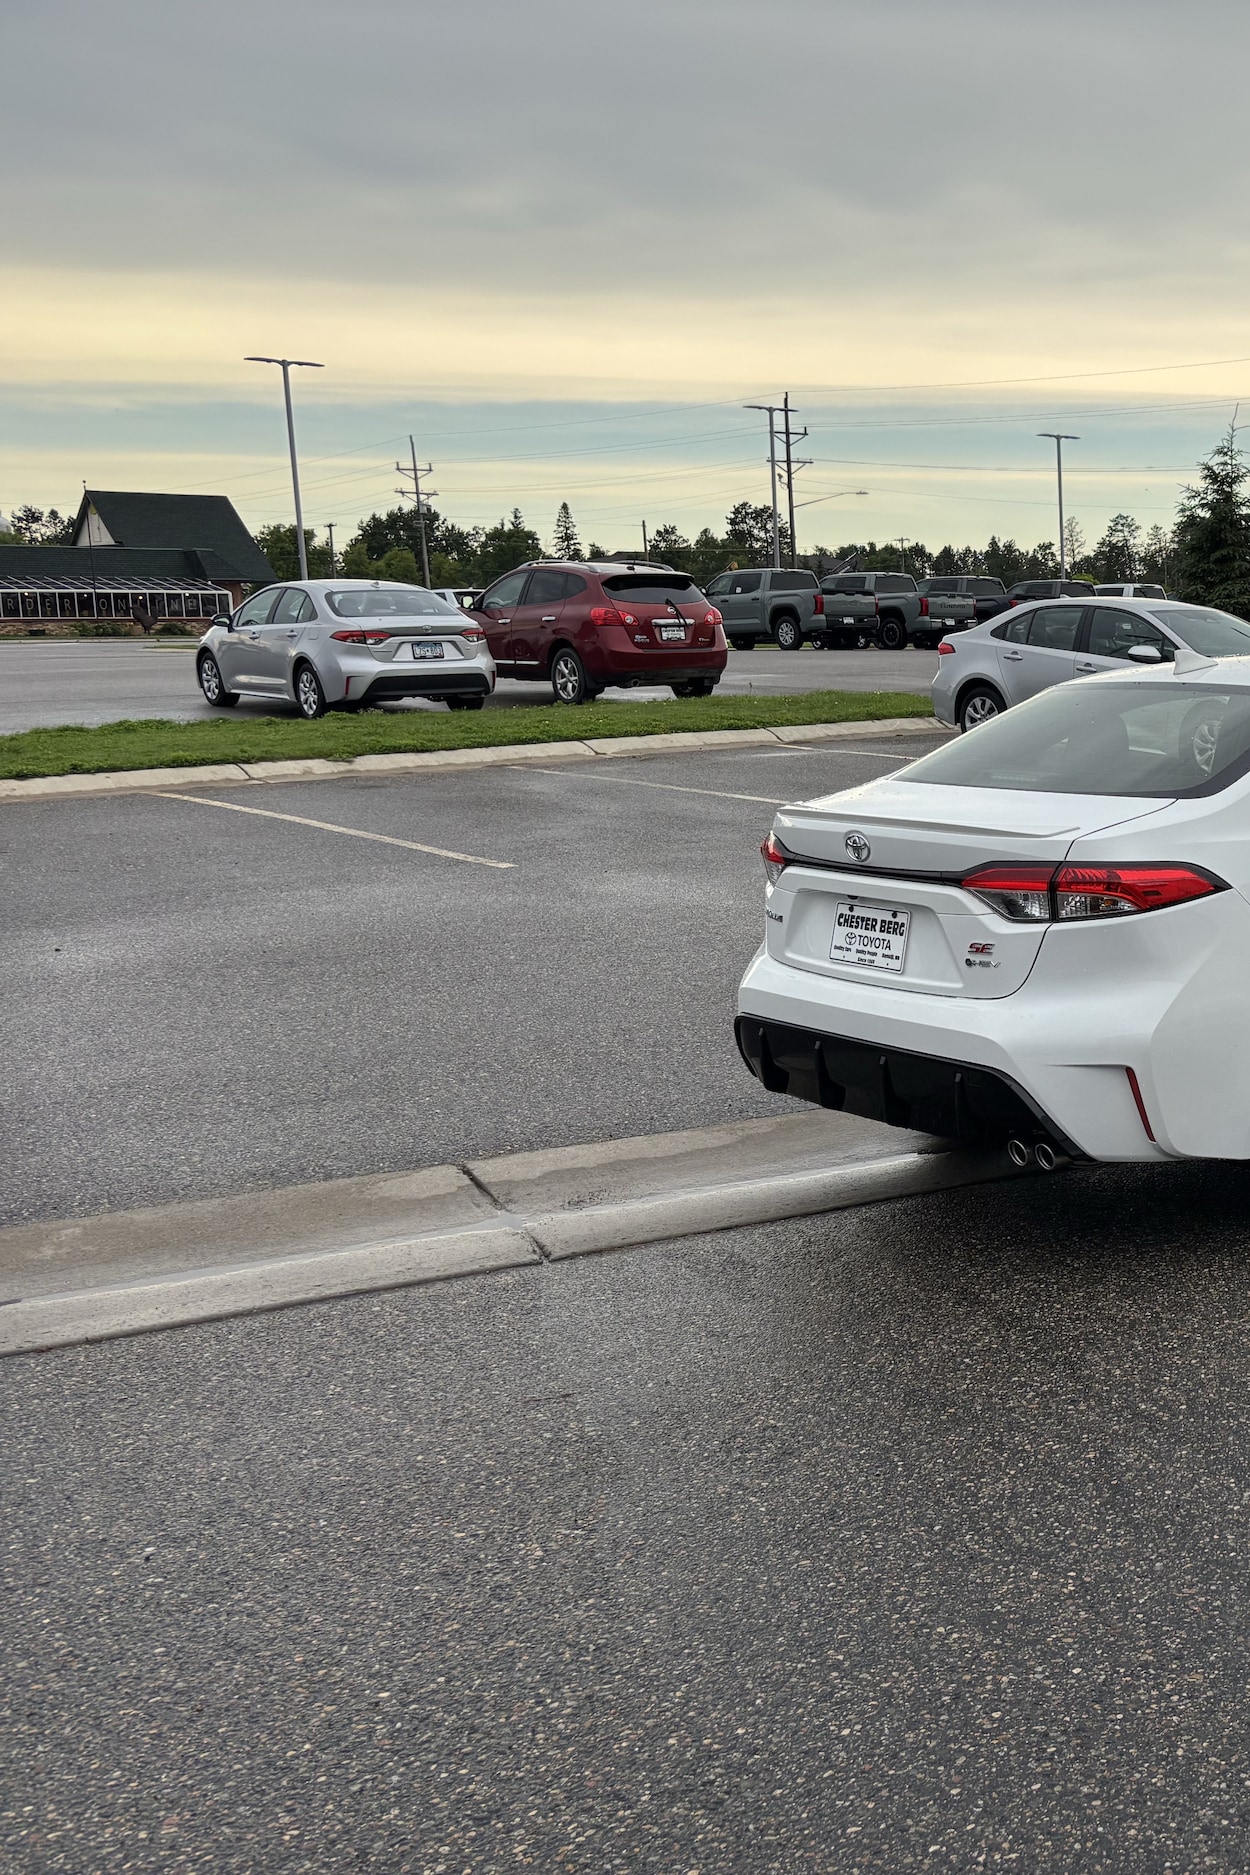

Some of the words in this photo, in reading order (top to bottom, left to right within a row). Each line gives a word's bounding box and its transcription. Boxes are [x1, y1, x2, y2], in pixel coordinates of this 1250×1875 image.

[838, 912, 878, 932] CHESTER
[880, 919, 906, 937] BERG
[858, 935, 891, 951] TOYOTA
[967, 942, 995, 954] SE
